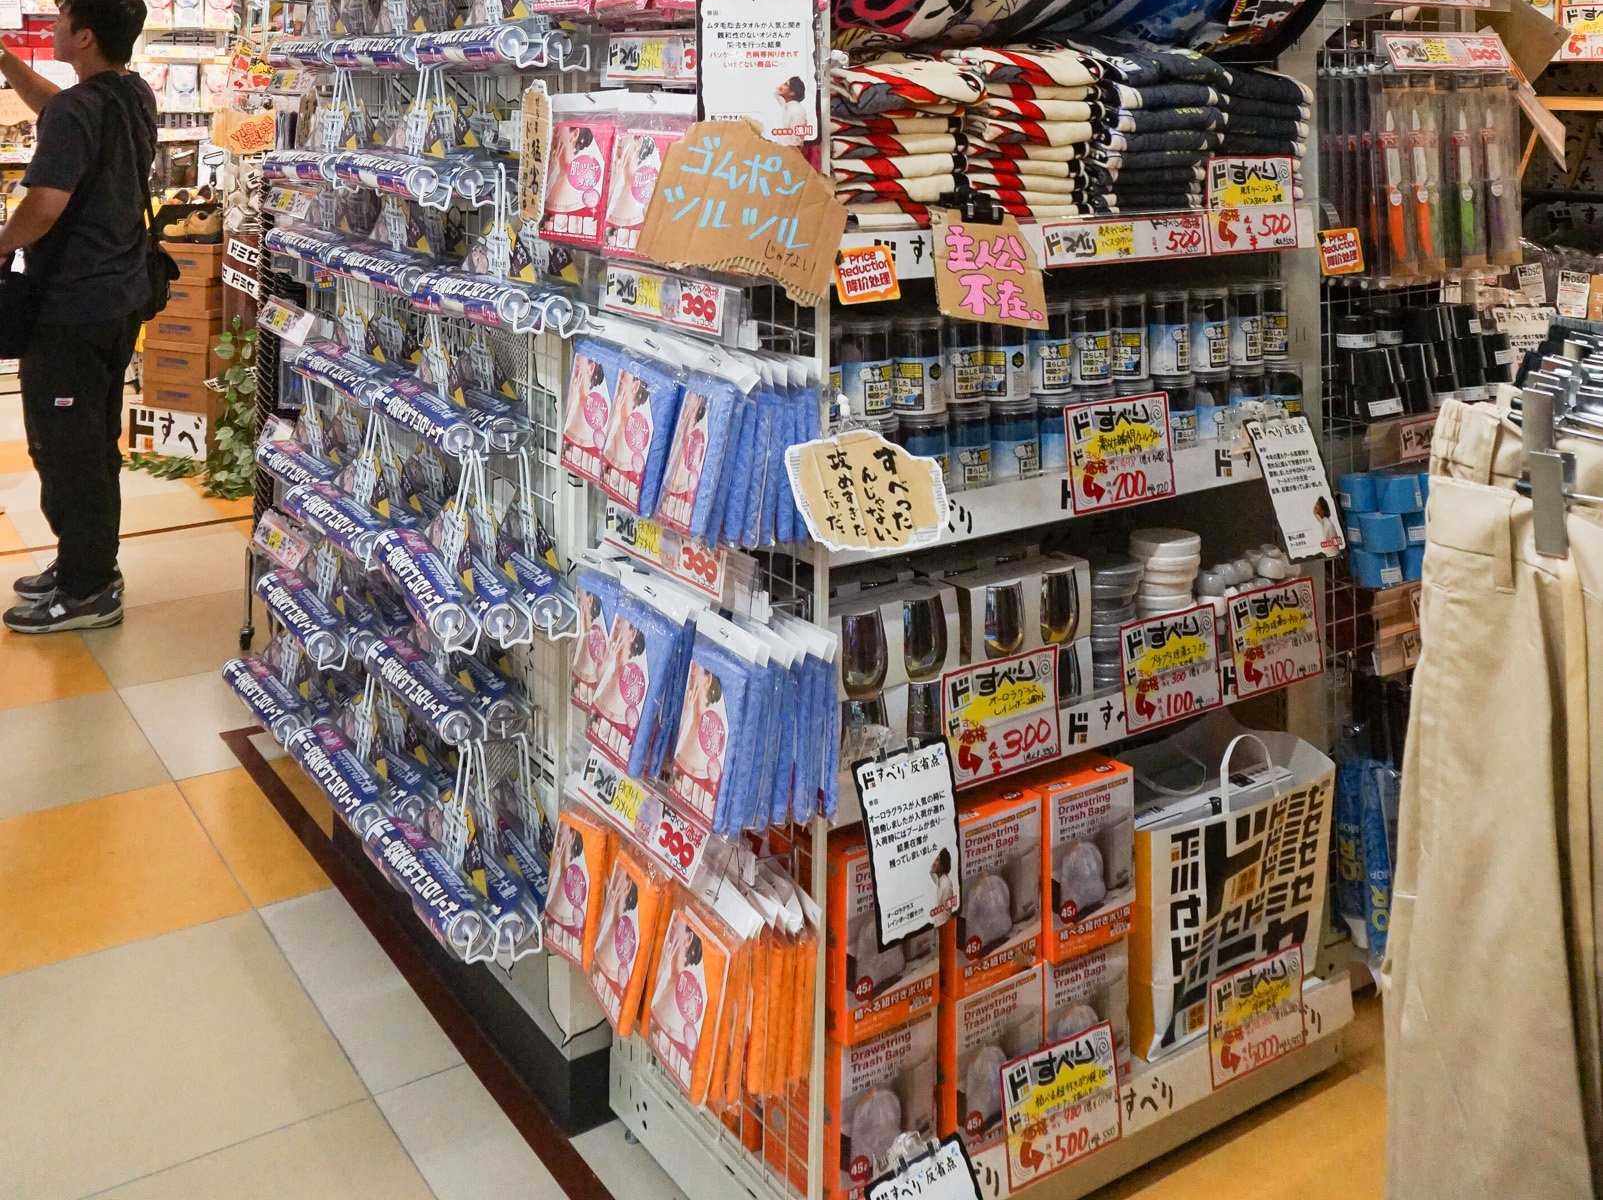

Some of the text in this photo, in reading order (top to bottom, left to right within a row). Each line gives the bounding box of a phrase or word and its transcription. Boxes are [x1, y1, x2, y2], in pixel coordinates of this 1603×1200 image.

[680, 136, 807, 199] ゴムポン
[1167, 229, 1201, 251] 500
[1260, 213, 1292, 238] 500
[1328, 233, 1348, 243] Price
[849, 250, 878, 266] Price
[944, 224, 1027, 275] 主人公
[839, 259, 890, 278] Reduction
[845, 271, 892, 295] 降价处理
[681, 290, 717, 320] 300
[957, 273, 1045, 322] 不在。
[826, 450, 867, 538] 攻めすぎた
[873, 446, 913, 531] すべった
[1112, 469, 1148, 502] 200
[862, 466, 899, 542] んじゃない、
[682, 545, 718, 586] 300
[1126, 615, 1200, 660] ドすべり
[950, 660, 1037, 709] ドすべり
[1269, 658, 1296, 684] 100
[1166, 690, 1194, 718] 100
[1000, 717, 1052, 760] 300
[909, 752, 942, 774] 反省点
[868, 790, 946, 824] オーロラグラスが人気の時に
[872, 803, 946, 837] 開発しましたが入荷が遅れ
[1057, 791, 1112, 818] Drawstring
[1059, 810, 1087, 827] Trash
[1088, 802, 1112, 820] Bags
[658, 821, 696, 868] 300
[964, 822, 1020, 850] Drawstring
[964, 832, 1021, 860] Trash Bags
[888, 843, 939, 870] 残ってしまいました
[1053, 953, 1107, 980] Drawstring
[1053, 962, 1108, 990] Trash Bags
[963, 991, 1018, 1022] Drawstring
[963, 1001, 1019, 1032] Trash Bags
[850, 1030, 913, 1063] Drawstring
[851, 1043, 913, 1073] Trash Bags
[1008, 1039, 1096, 1103] ドすべり
[1054, 1126, 1090, 1164] 500
[926, 1153, 958, 1185] 反省点
